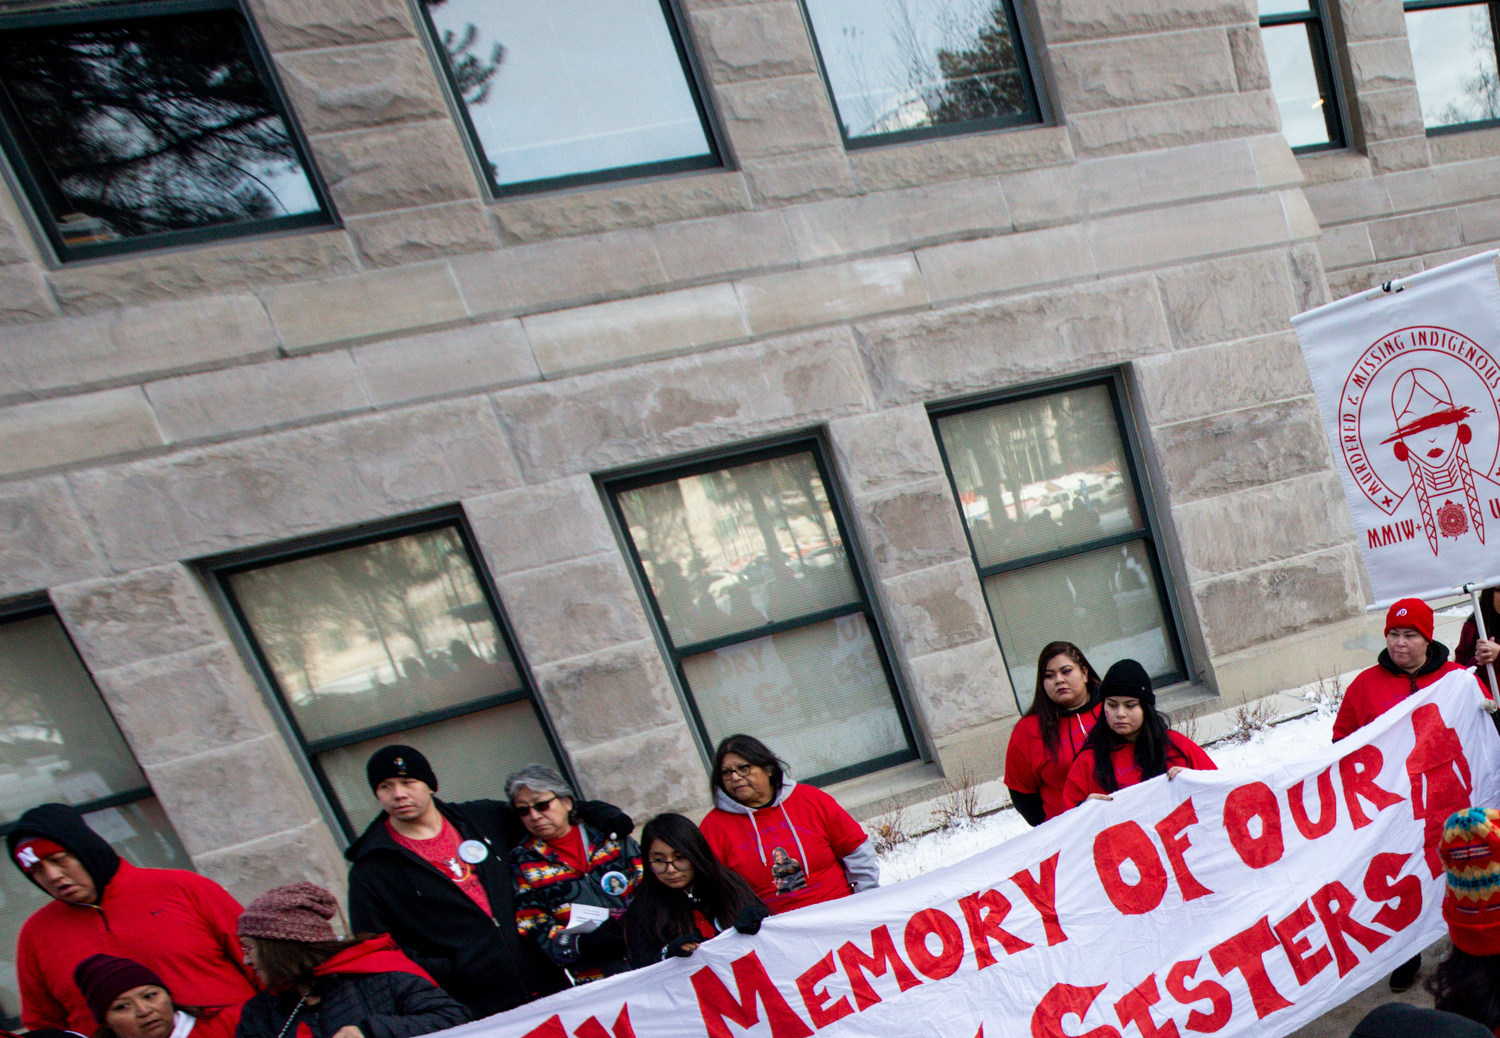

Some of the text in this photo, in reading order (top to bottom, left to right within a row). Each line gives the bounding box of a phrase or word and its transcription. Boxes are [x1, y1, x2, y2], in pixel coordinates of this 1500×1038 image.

[1352, 335, 1405, 389] MISSING
[1343, 413, 1382, 496] MURDERED
[17, 846, 40, 868] N
[1093, 797, 1214, 914] OF
[1223, 745, 1407, 868] OUR
